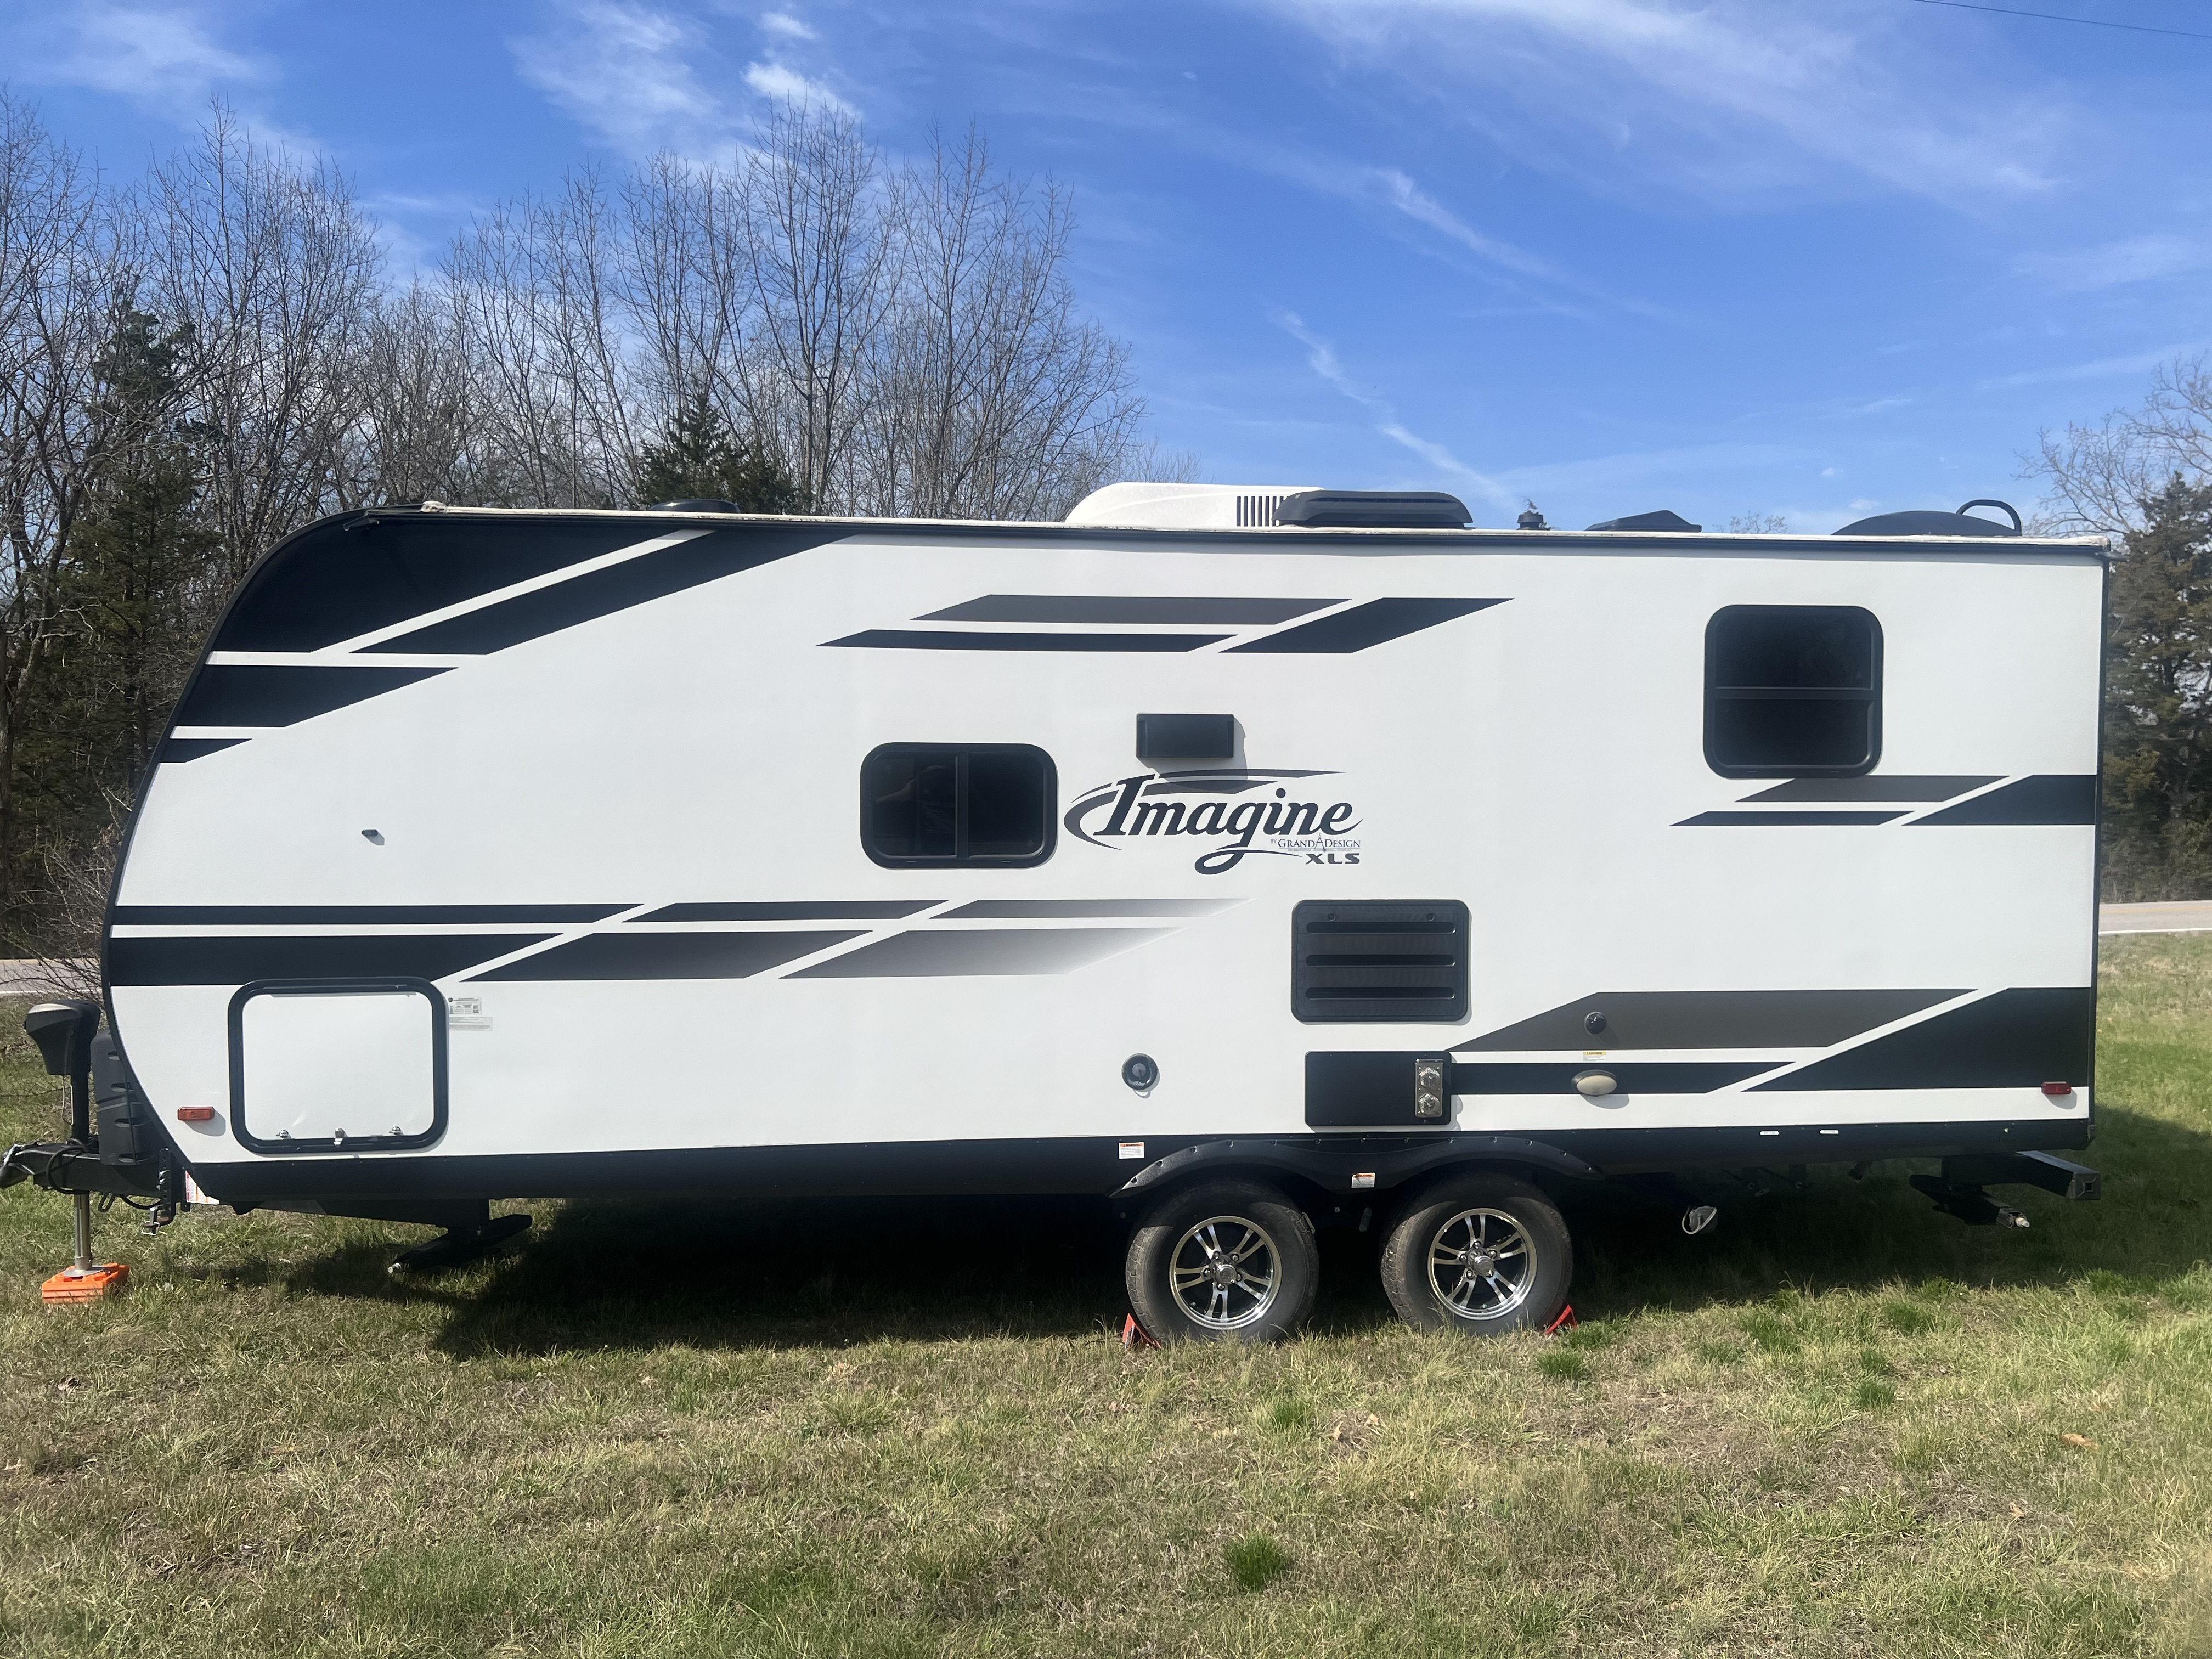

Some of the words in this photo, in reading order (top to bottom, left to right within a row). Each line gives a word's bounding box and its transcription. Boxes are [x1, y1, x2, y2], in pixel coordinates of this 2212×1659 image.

[1093, 774, 1364, 876] Imagine
[1278, 839, 1315, 848] GRAND
[1324, 839, 1361, 848] DESIGN
[1305, 853, 1361, 865] XLS
